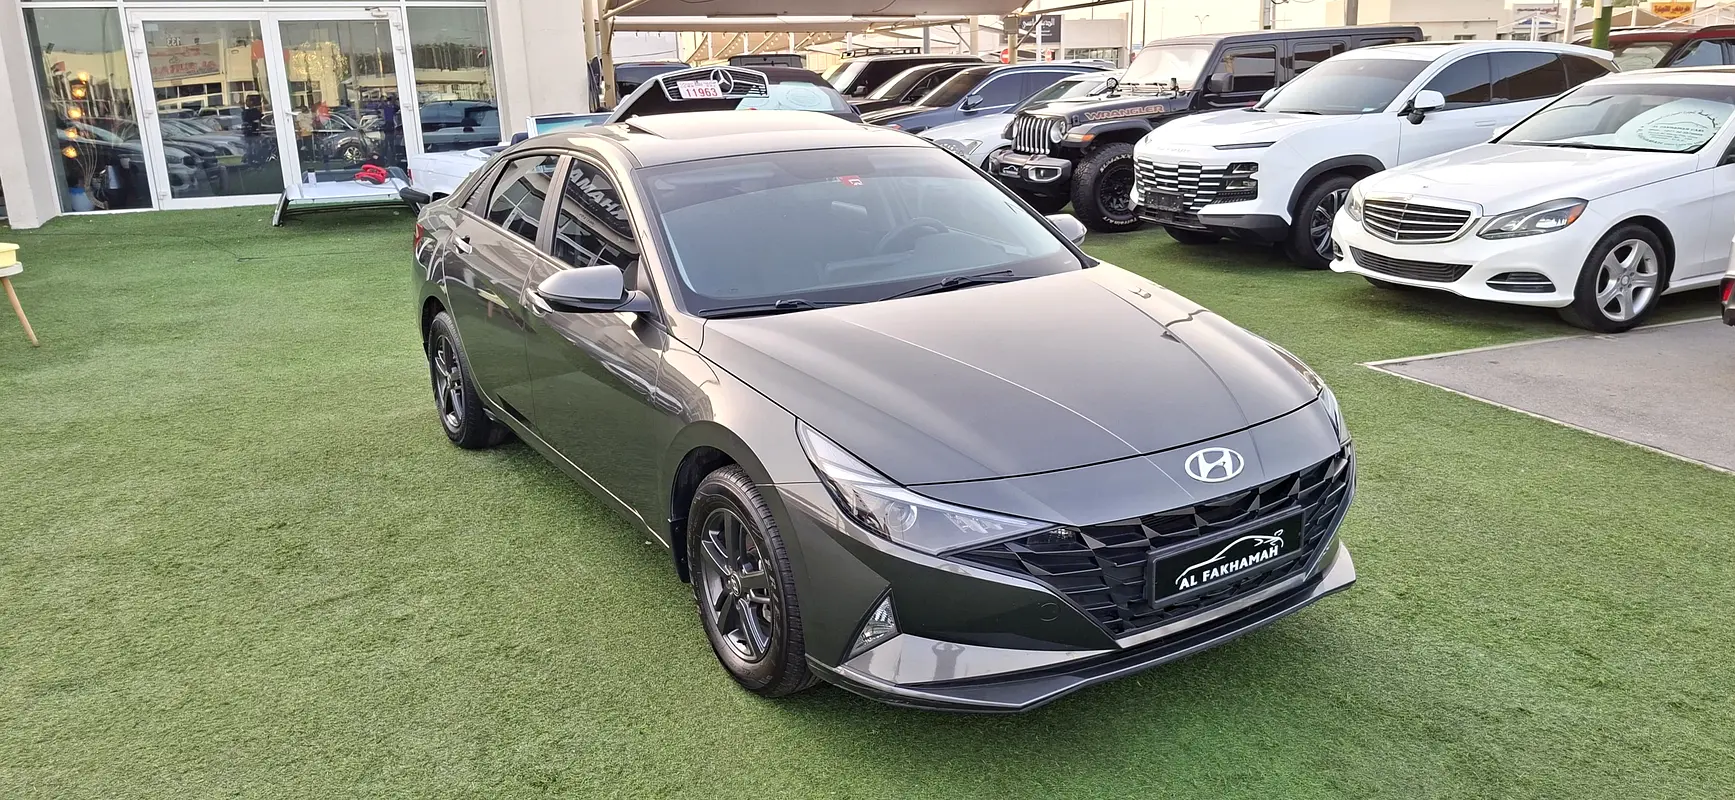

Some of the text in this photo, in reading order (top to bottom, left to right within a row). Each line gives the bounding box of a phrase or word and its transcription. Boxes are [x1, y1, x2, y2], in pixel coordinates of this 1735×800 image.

[686, 88, 717, 97] 11963
[1084, 104, 1165, 120] WRANGLER
[1179, 545, 1278, 590] AL FAKHAMAH
